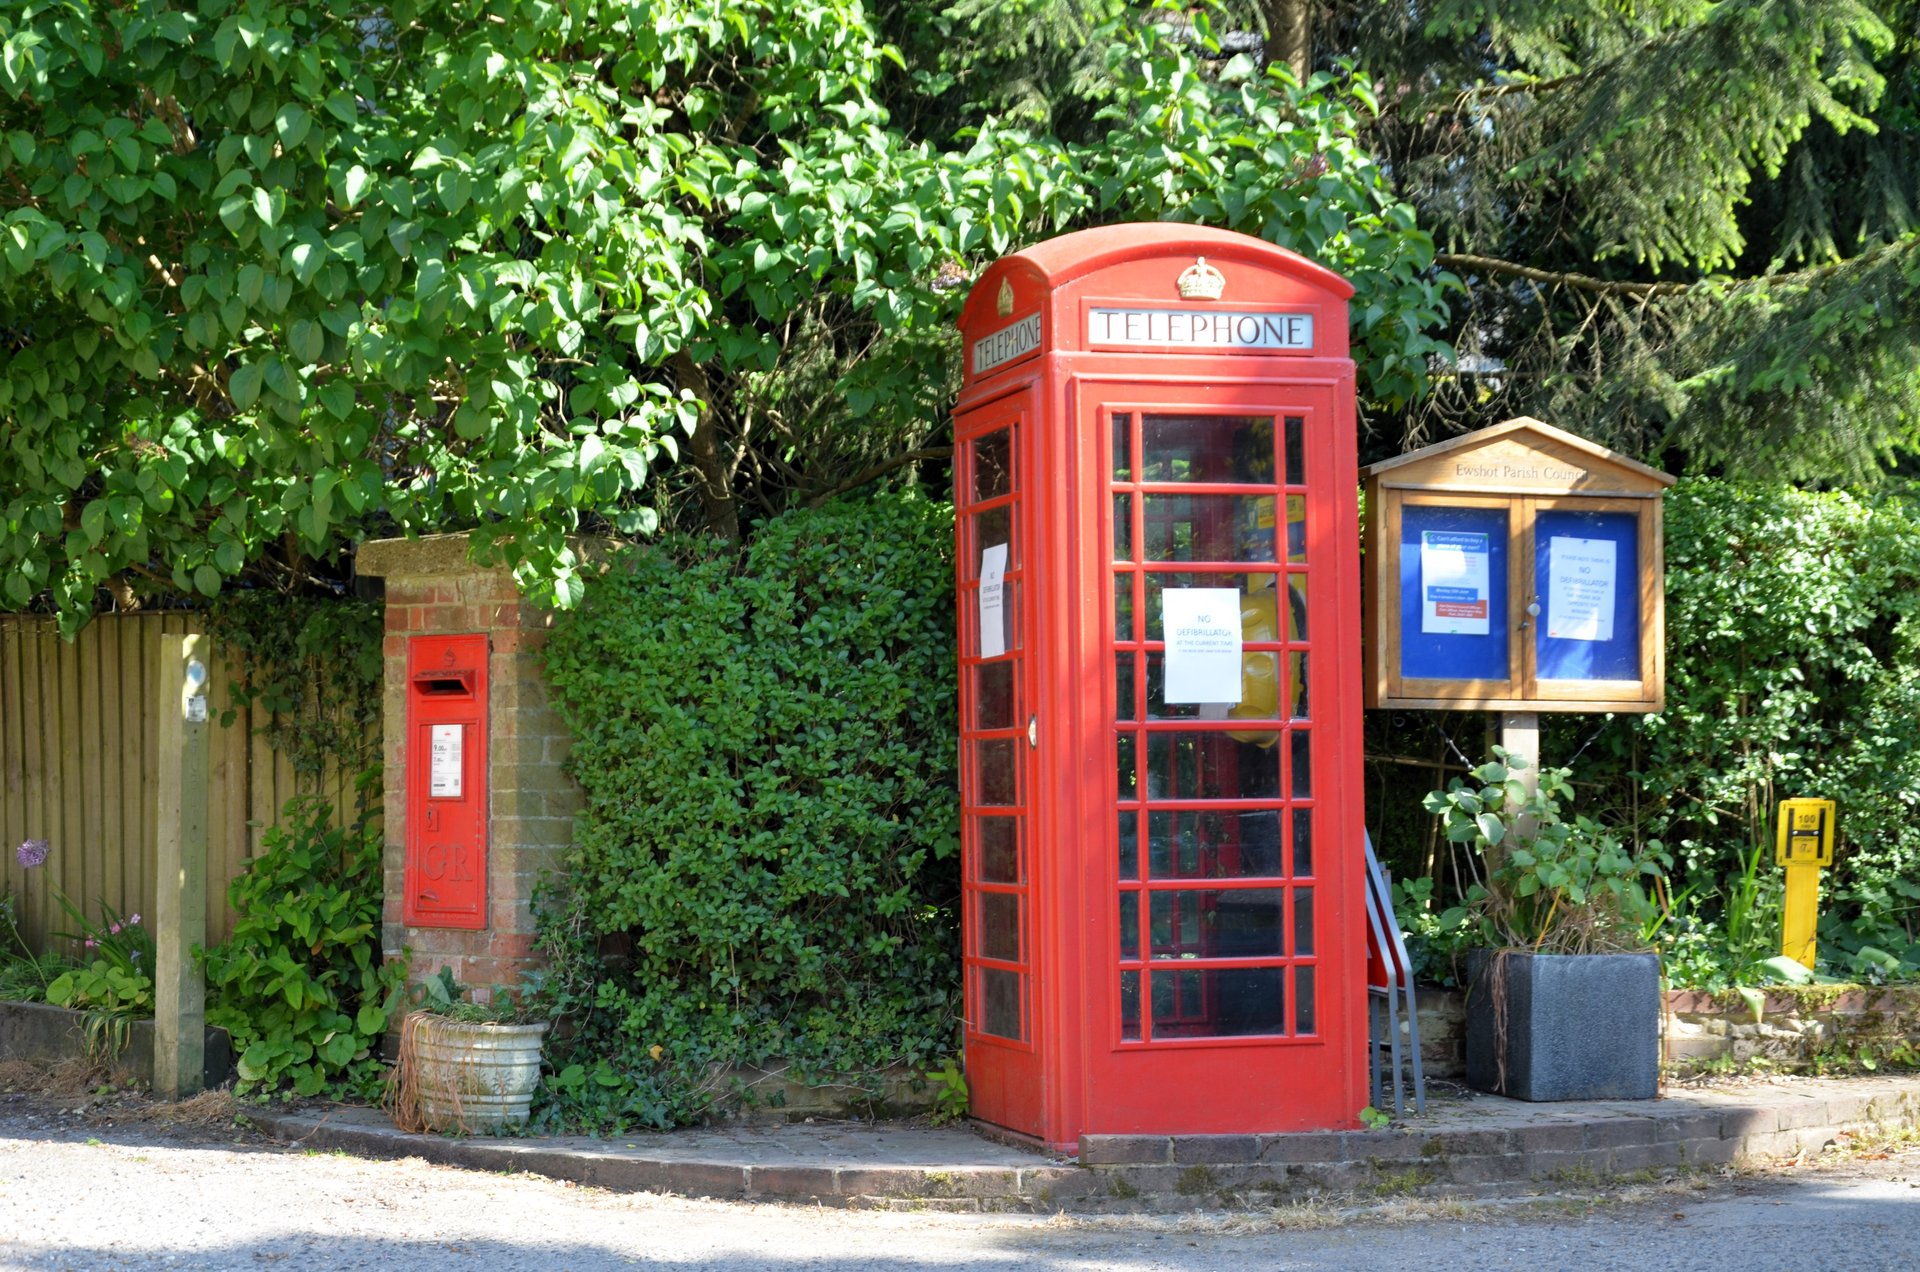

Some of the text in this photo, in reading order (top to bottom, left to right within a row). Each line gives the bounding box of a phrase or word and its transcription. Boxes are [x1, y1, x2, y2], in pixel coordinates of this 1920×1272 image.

[1097, 312, 1304, 345] TELEPHONE
[977, 315, 1041, 370] TELEPHONE
[1456, 463, 1588, 481] Ewshot Parish Council
[1579, 566, 1591, 574] NO
[1197, 614, 1211, 624] NO
[1176, 628, 1233, 637] DEFIBRILLATOR
[1798, 814, 1817, 824] 100
